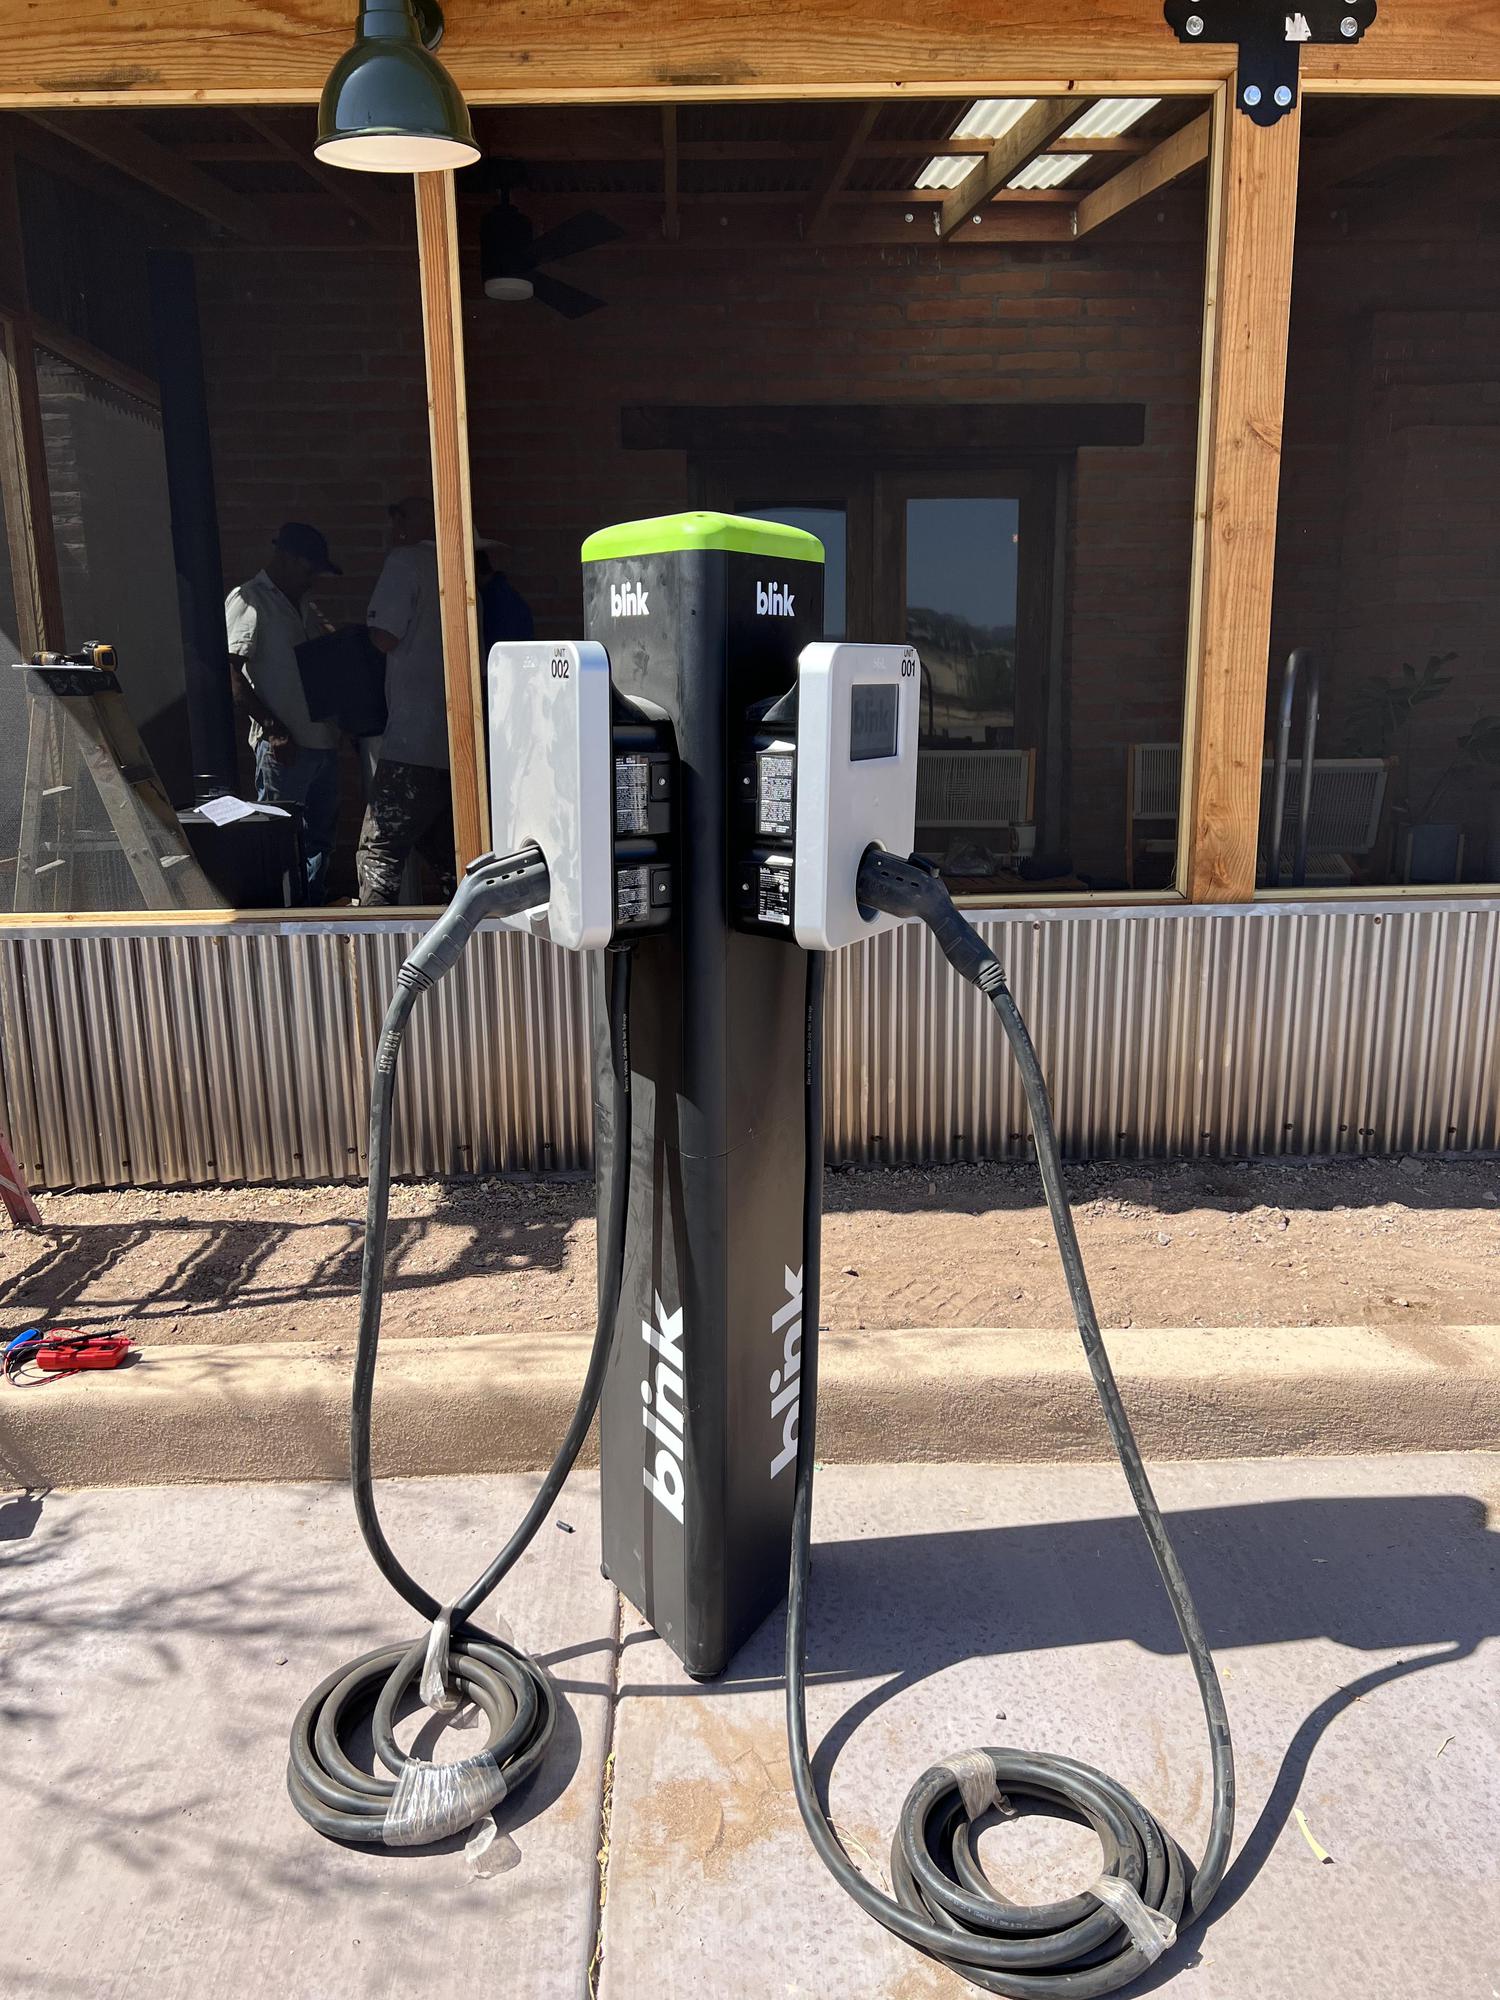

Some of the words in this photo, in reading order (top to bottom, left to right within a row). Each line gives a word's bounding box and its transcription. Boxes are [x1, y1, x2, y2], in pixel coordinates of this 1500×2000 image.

[610, 581, 650, 618] blink
[756, 580, 796, 617] blink
[551, 659, 569, 679] 002
[554, 648, 566, 657] UNIT
[901, 659, 916, 678] 001
[769, 1263, 803, 1480] blink
[640, 1287, 685, 1525] blink
